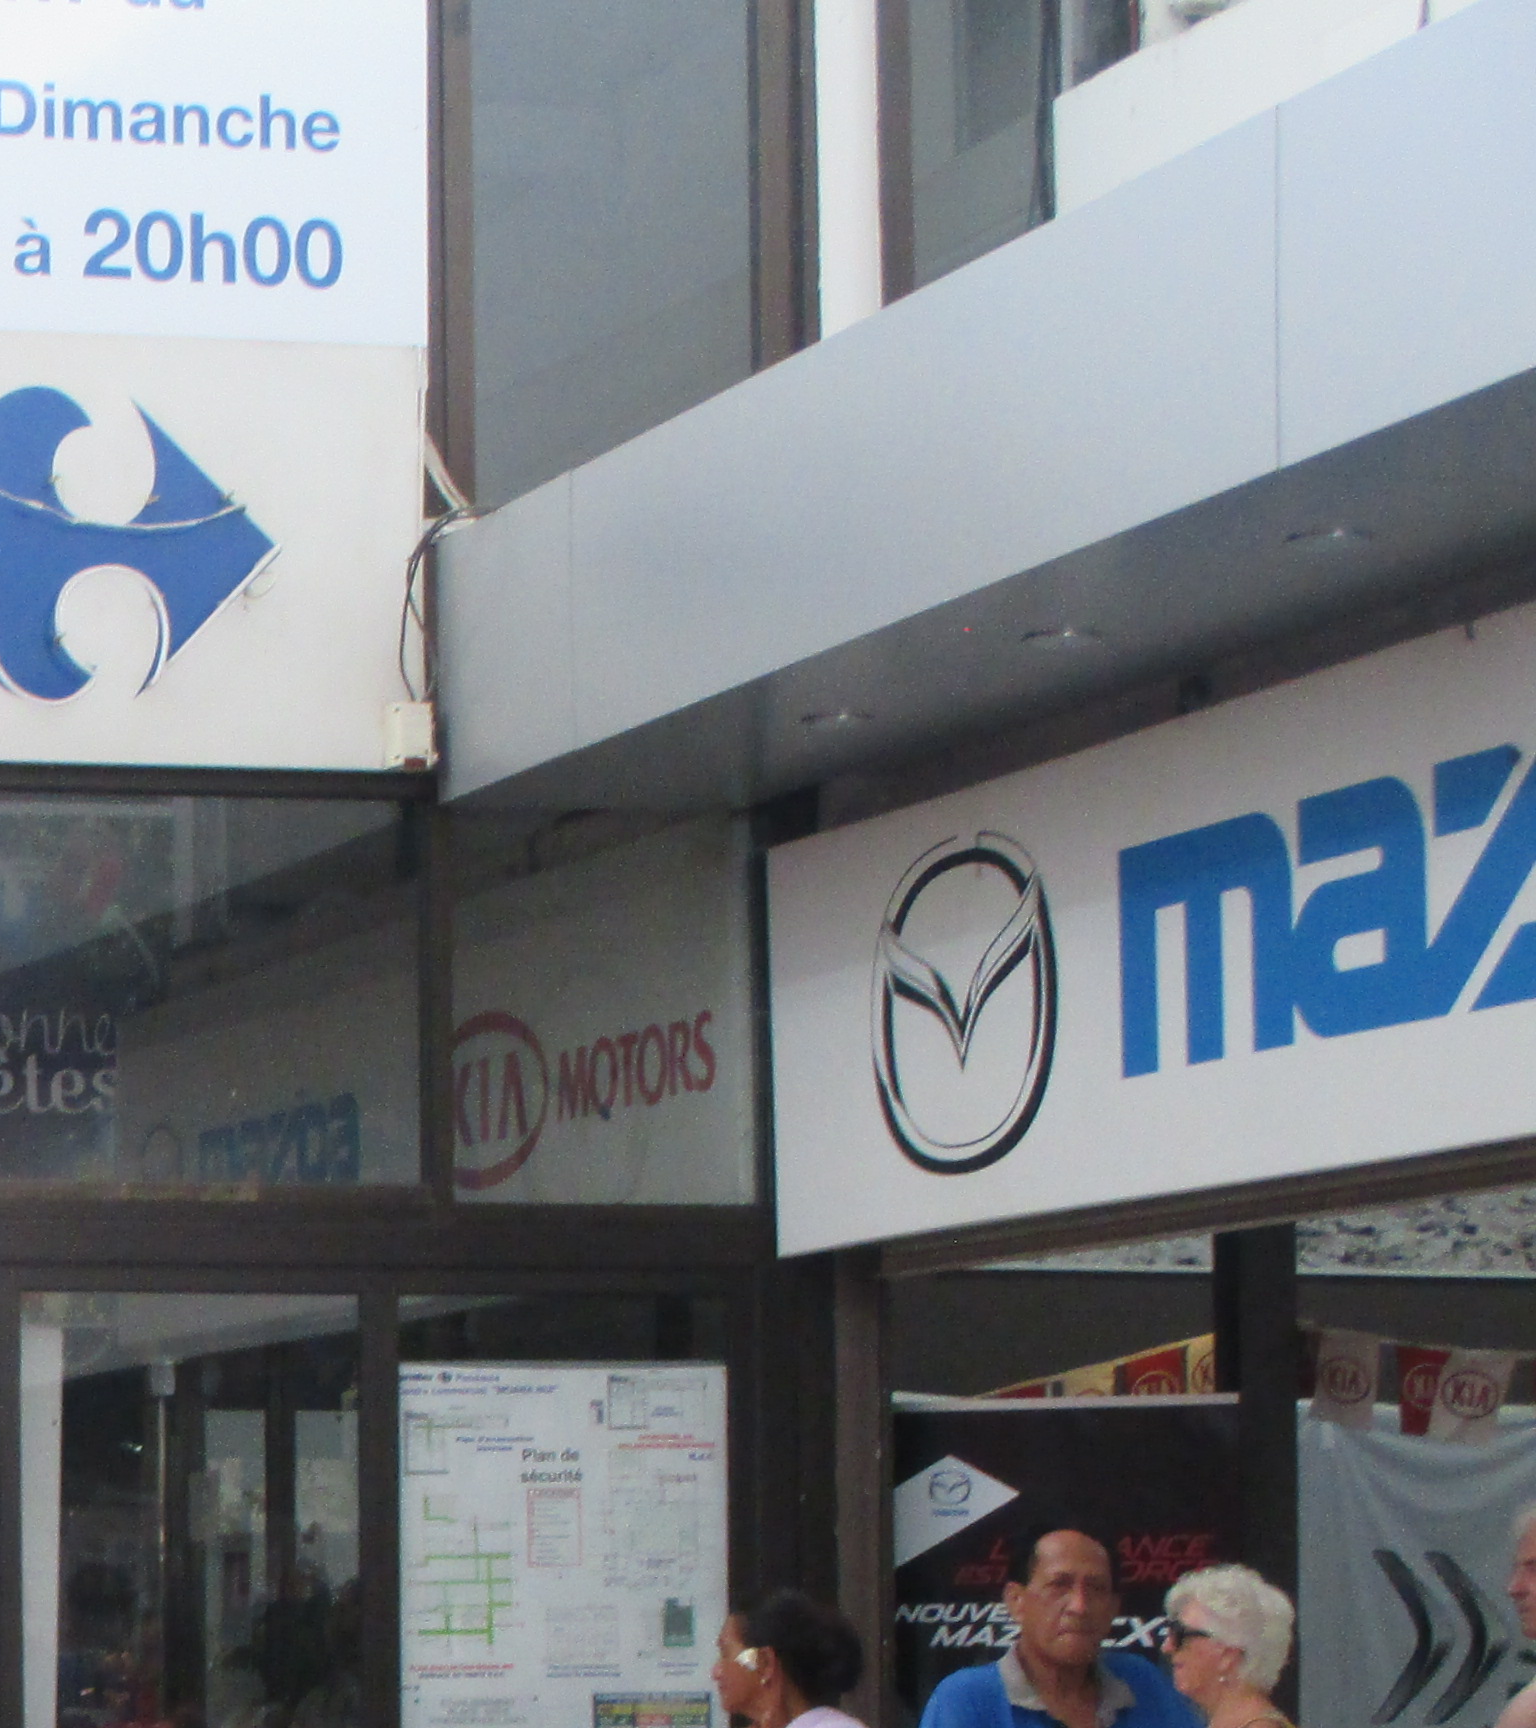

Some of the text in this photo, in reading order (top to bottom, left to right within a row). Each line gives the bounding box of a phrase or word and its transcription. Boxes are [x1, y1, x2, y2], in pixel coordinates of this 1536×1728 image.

[13, 216, 53, 277] à
[83, 206, 346, 290] 20h00
[557, 1008, 717, 1123] MOTORS
[929, 1623, 1026, 1648] MAZ
